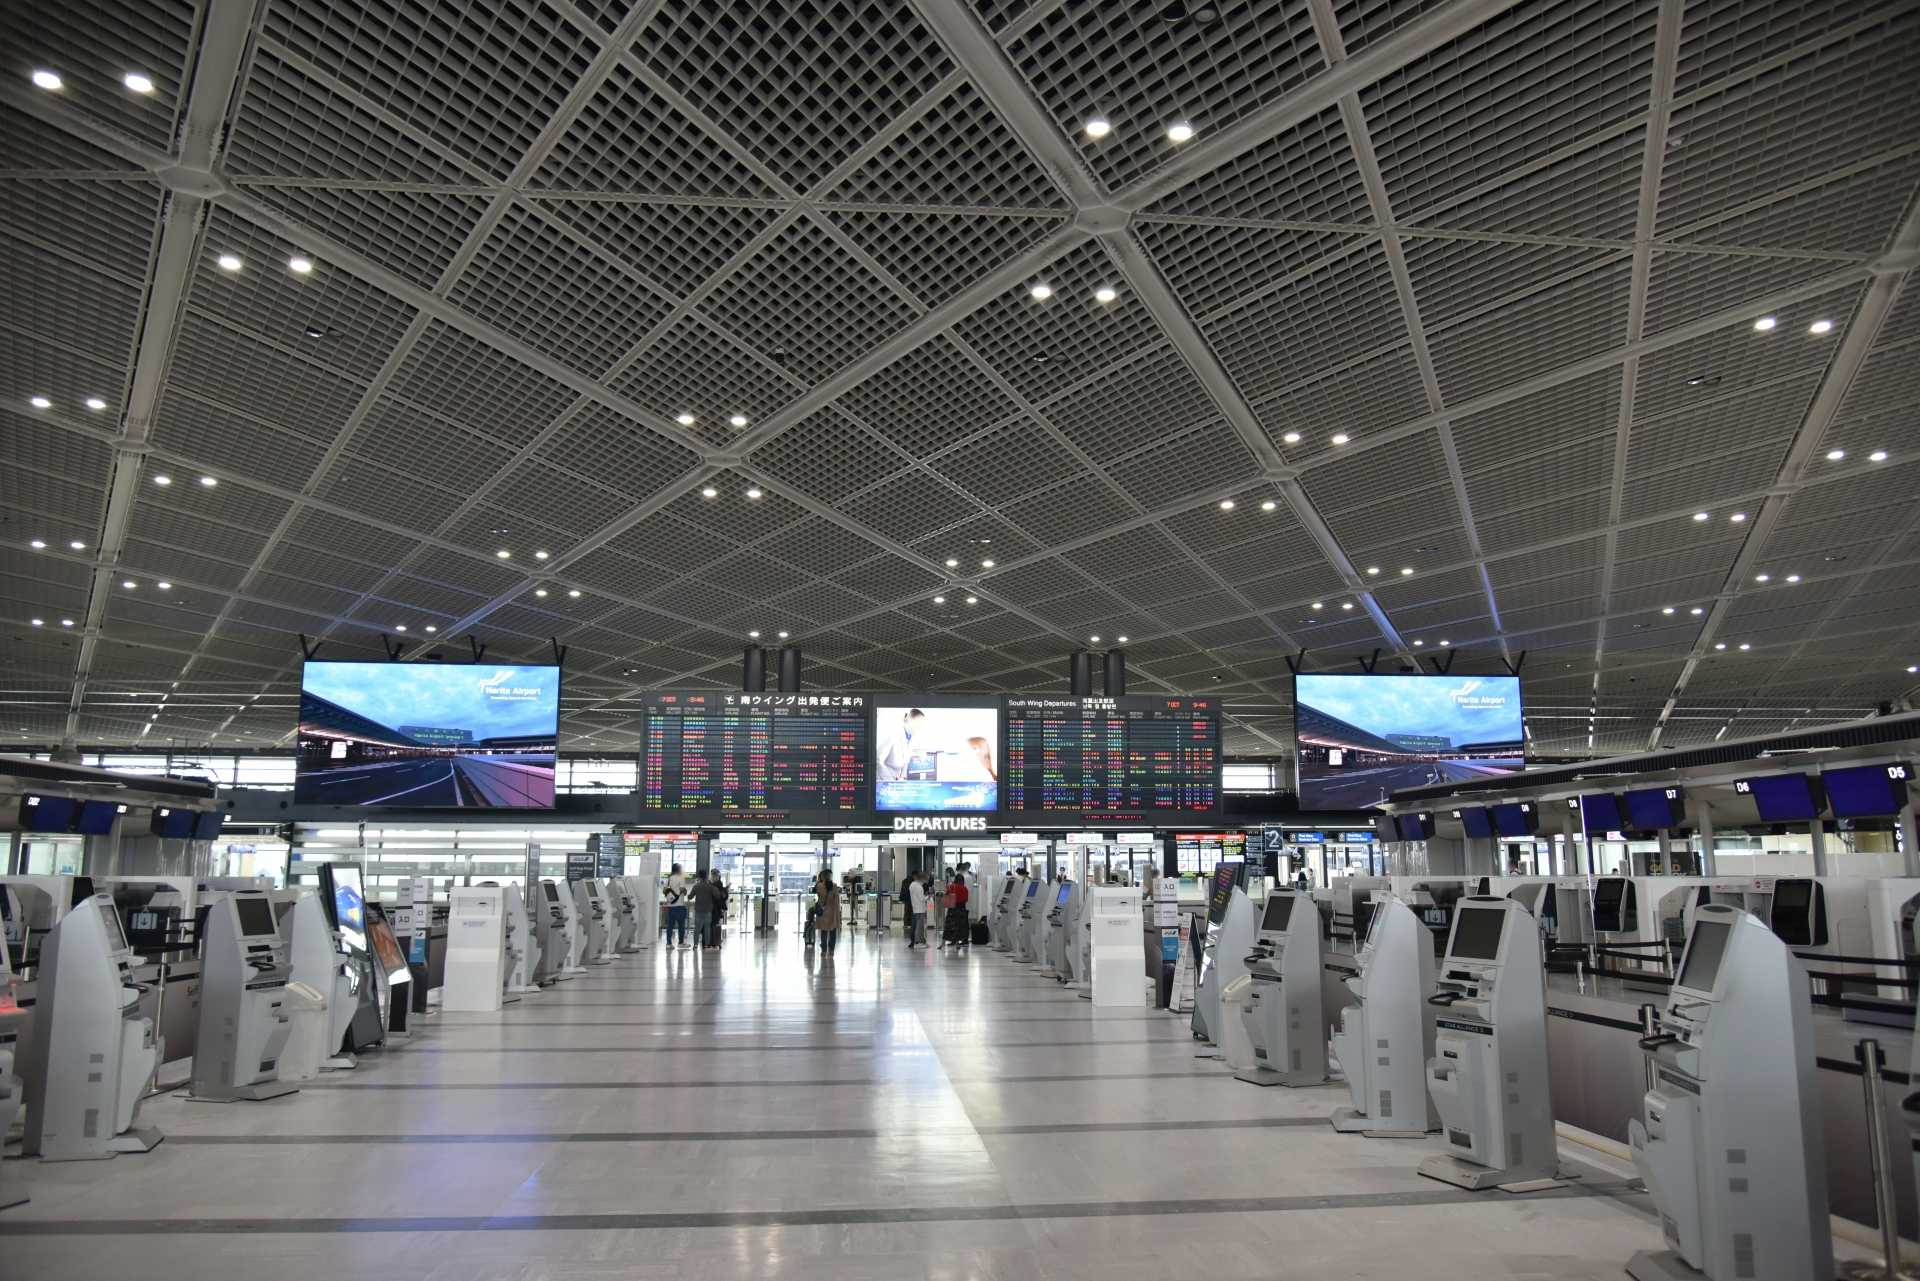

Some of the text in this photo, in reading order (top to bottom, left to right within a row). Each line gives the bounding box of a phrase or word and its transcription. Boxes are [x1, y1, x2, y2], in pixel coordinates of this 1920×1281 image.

[512, 687, 541, 697] Airport
[1027, 700, 1043, 708] Wing
[1044, 700, 1077, 708] Departures
[1887, 766, 1906, 779] D5
[1736, 782, 1750, 793] D6
[1665, 789, 1677, 799] D7
[893, 817, 987, 831] DEPARTURES
[1267, 830, 1280, 848] 2
